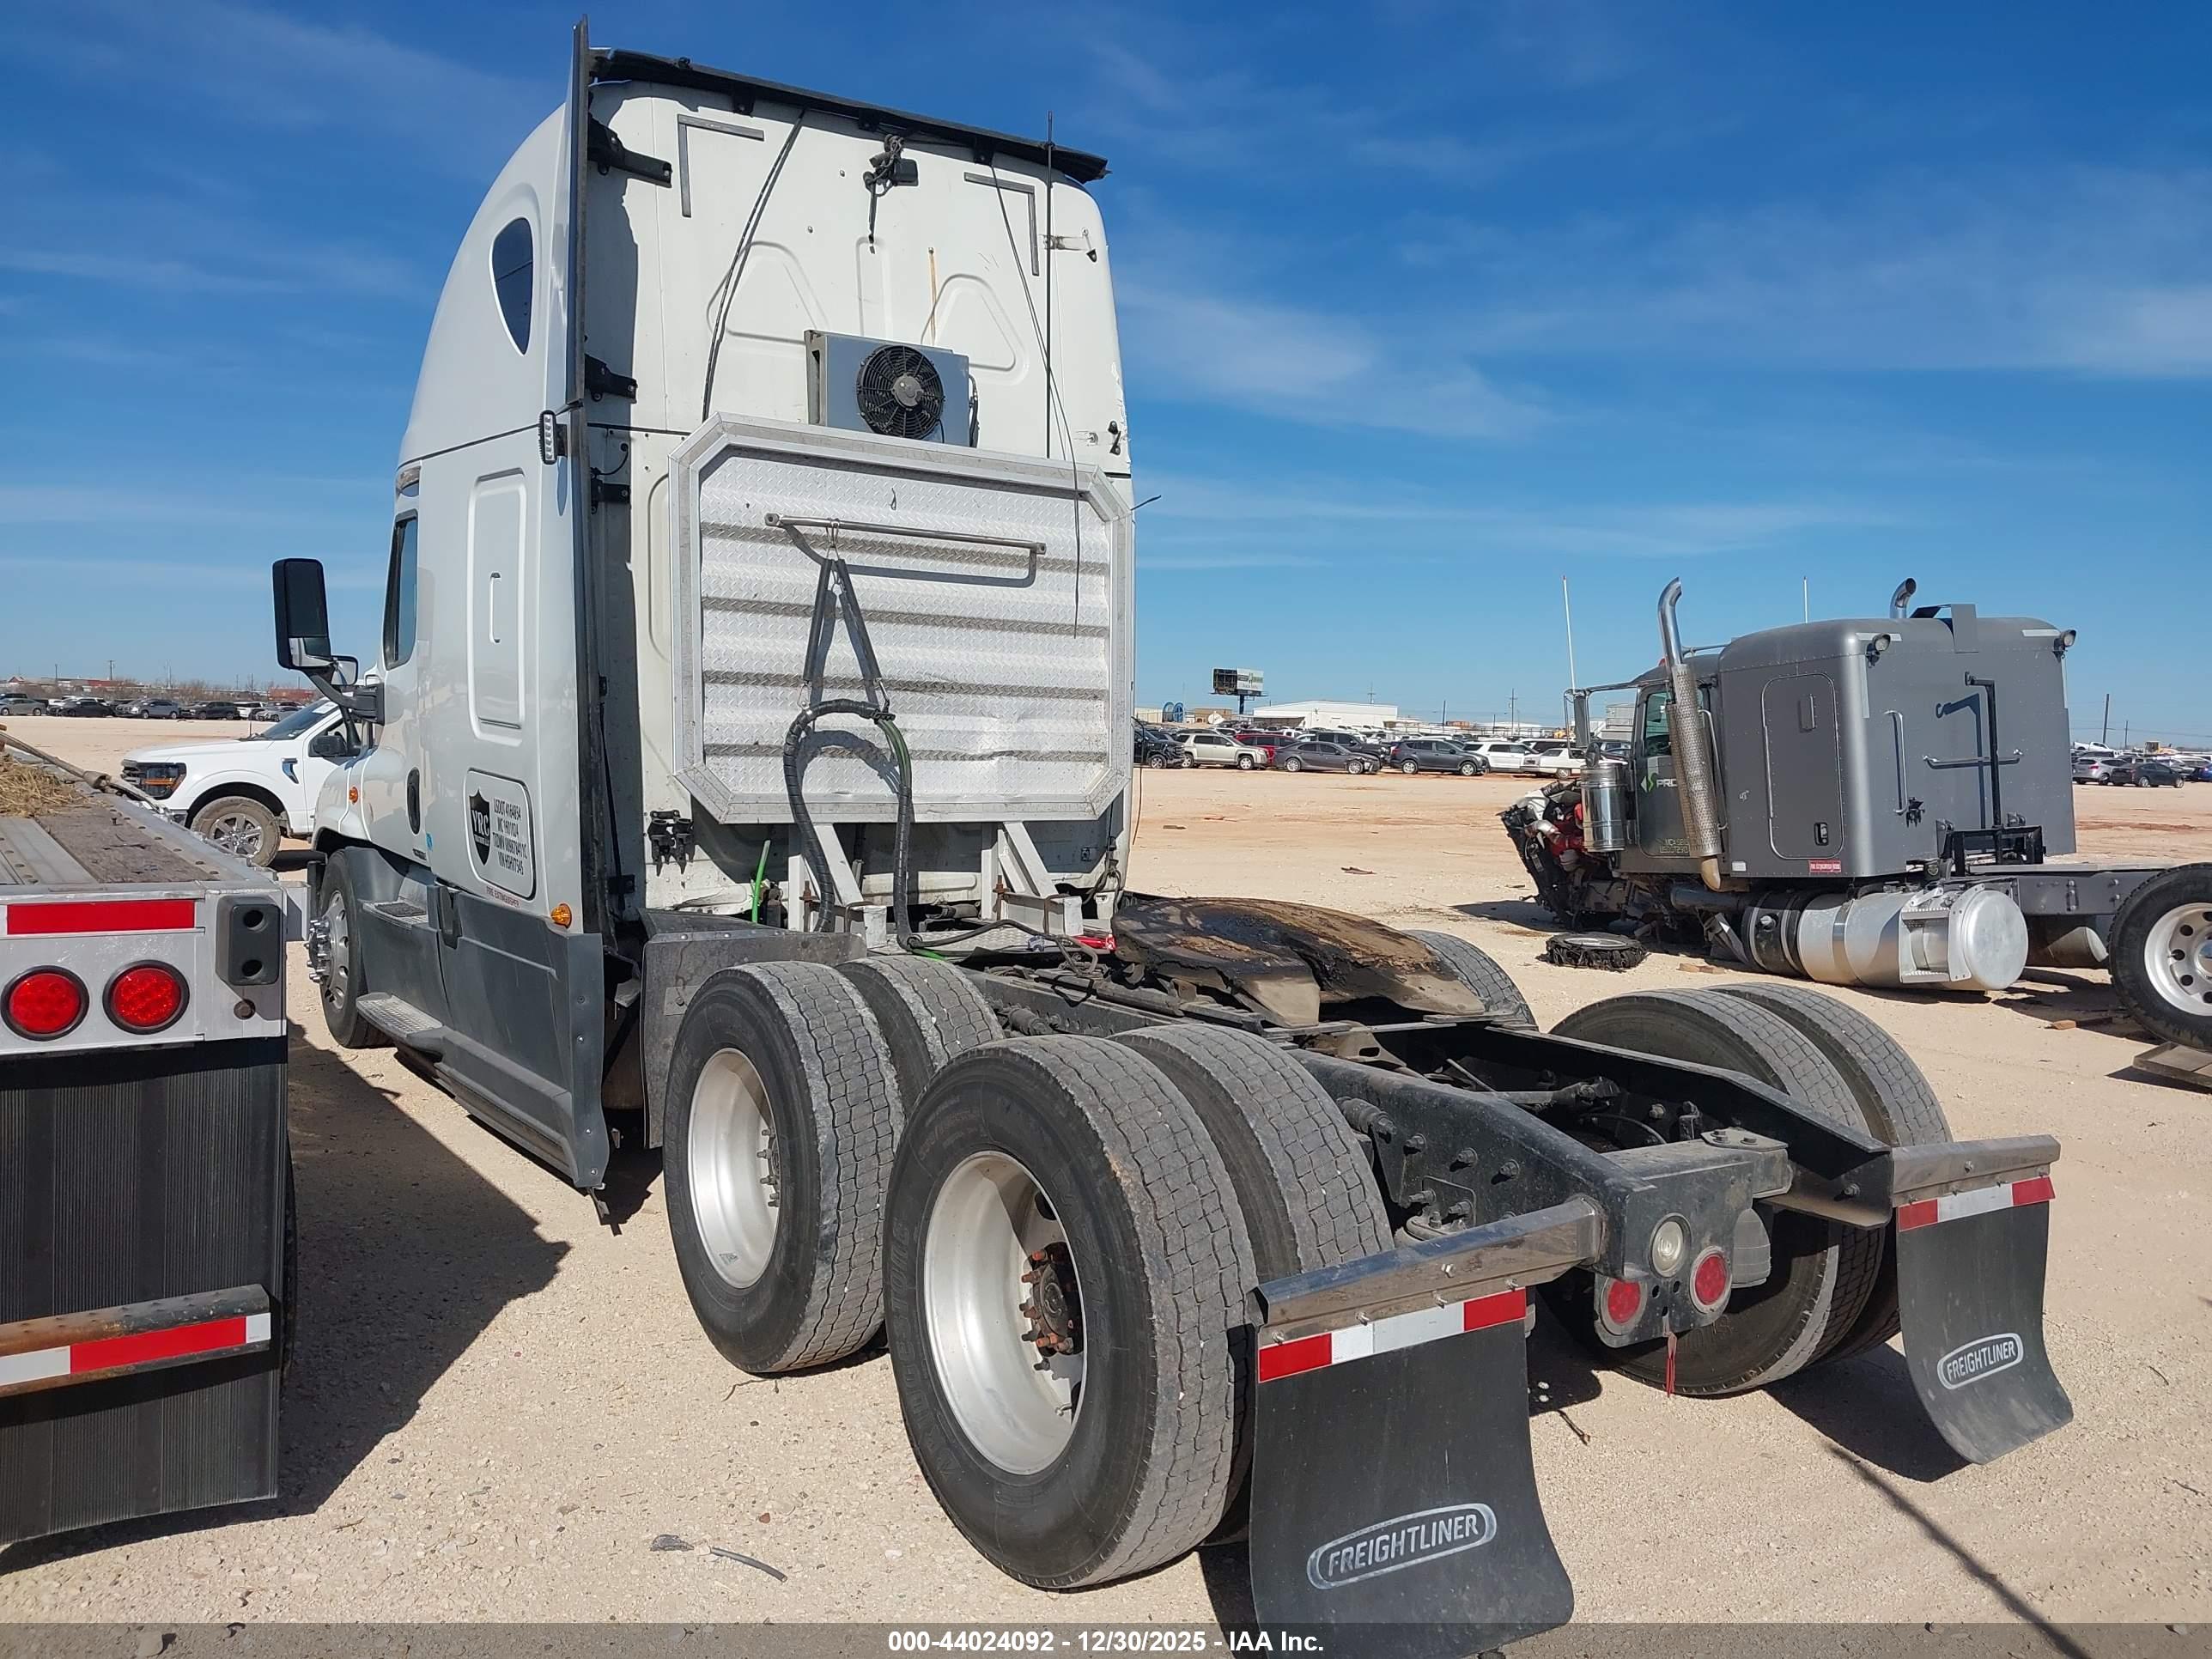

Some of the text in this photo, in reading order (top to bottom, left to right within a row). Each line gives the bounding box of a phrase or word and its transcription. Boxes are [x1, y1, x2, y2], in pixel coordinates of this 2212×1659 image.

[471, 810, 489, 836] YRC
[1947, 1340, 2016, 1382] FREIGHTLINER
[1328, 1514, 1479, 1577] FREIGHTLINER
